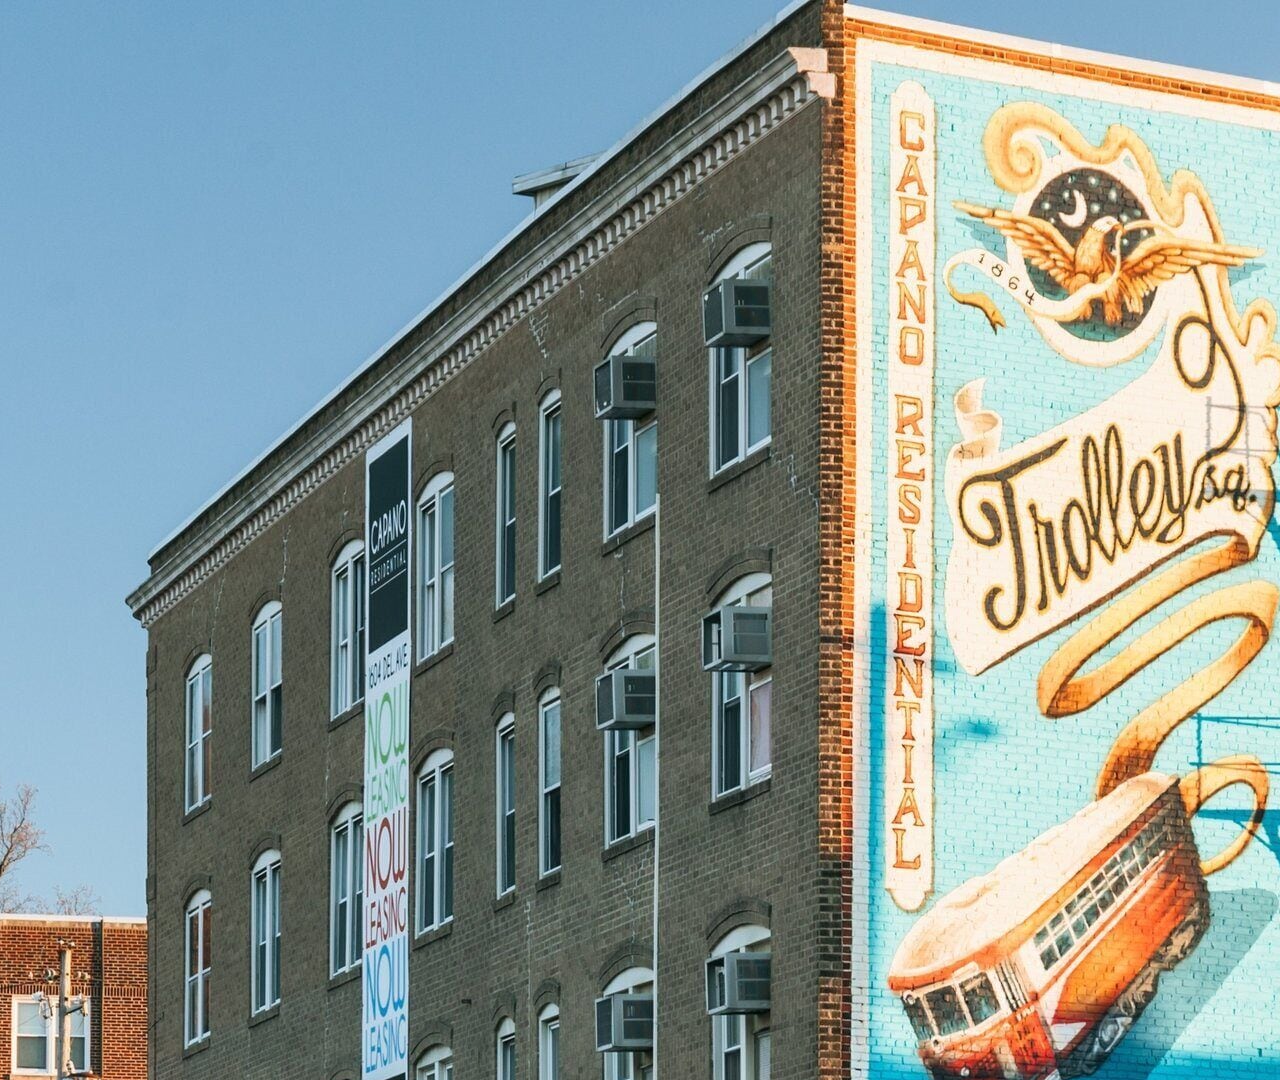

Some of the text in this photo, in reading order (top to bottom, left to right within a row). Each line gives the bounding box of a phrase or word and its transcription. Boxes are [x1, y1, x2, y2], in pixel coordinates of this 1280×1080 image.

[894, 109, 928, 367] CAPANO
[977, 253, 1036, 306] 1864
[370, 499, 407, 555] CAPANO
[957, 422, 1190, 632] Trolley
[370, 548, 407, 587] RESIDENTIAL
[890, 394, 928, 871] RESIDENTIAL
[367, 679, 408, 774] NOW
[366, 757, 407, 823] LEASING
[366, 806, 407, 898] NOW
[365, 886, 406, 950] LEASING
[366, 935, 406, 1024] NOW
[365, 1013, 406, 1074] LEASING
